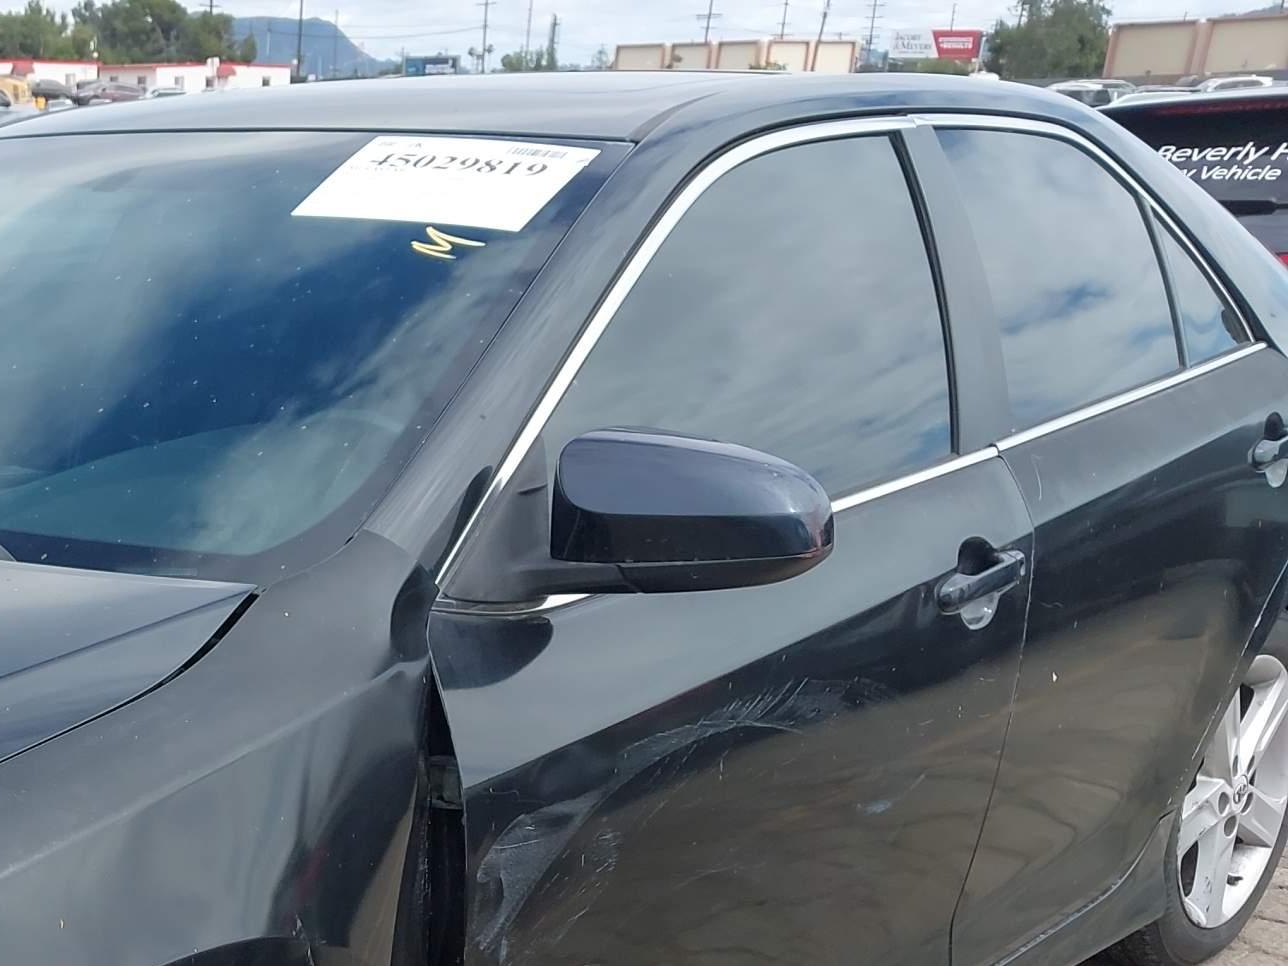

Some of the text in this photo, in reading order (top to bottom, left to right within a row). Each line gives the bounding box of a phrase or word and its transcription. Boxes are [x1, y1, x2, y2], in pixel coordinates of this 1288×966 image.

[369, 152, 549, 177] 45029819
[1158, 142, 1269, 165] Beverly
[1201, 164, 1282, 180] Vehicle
